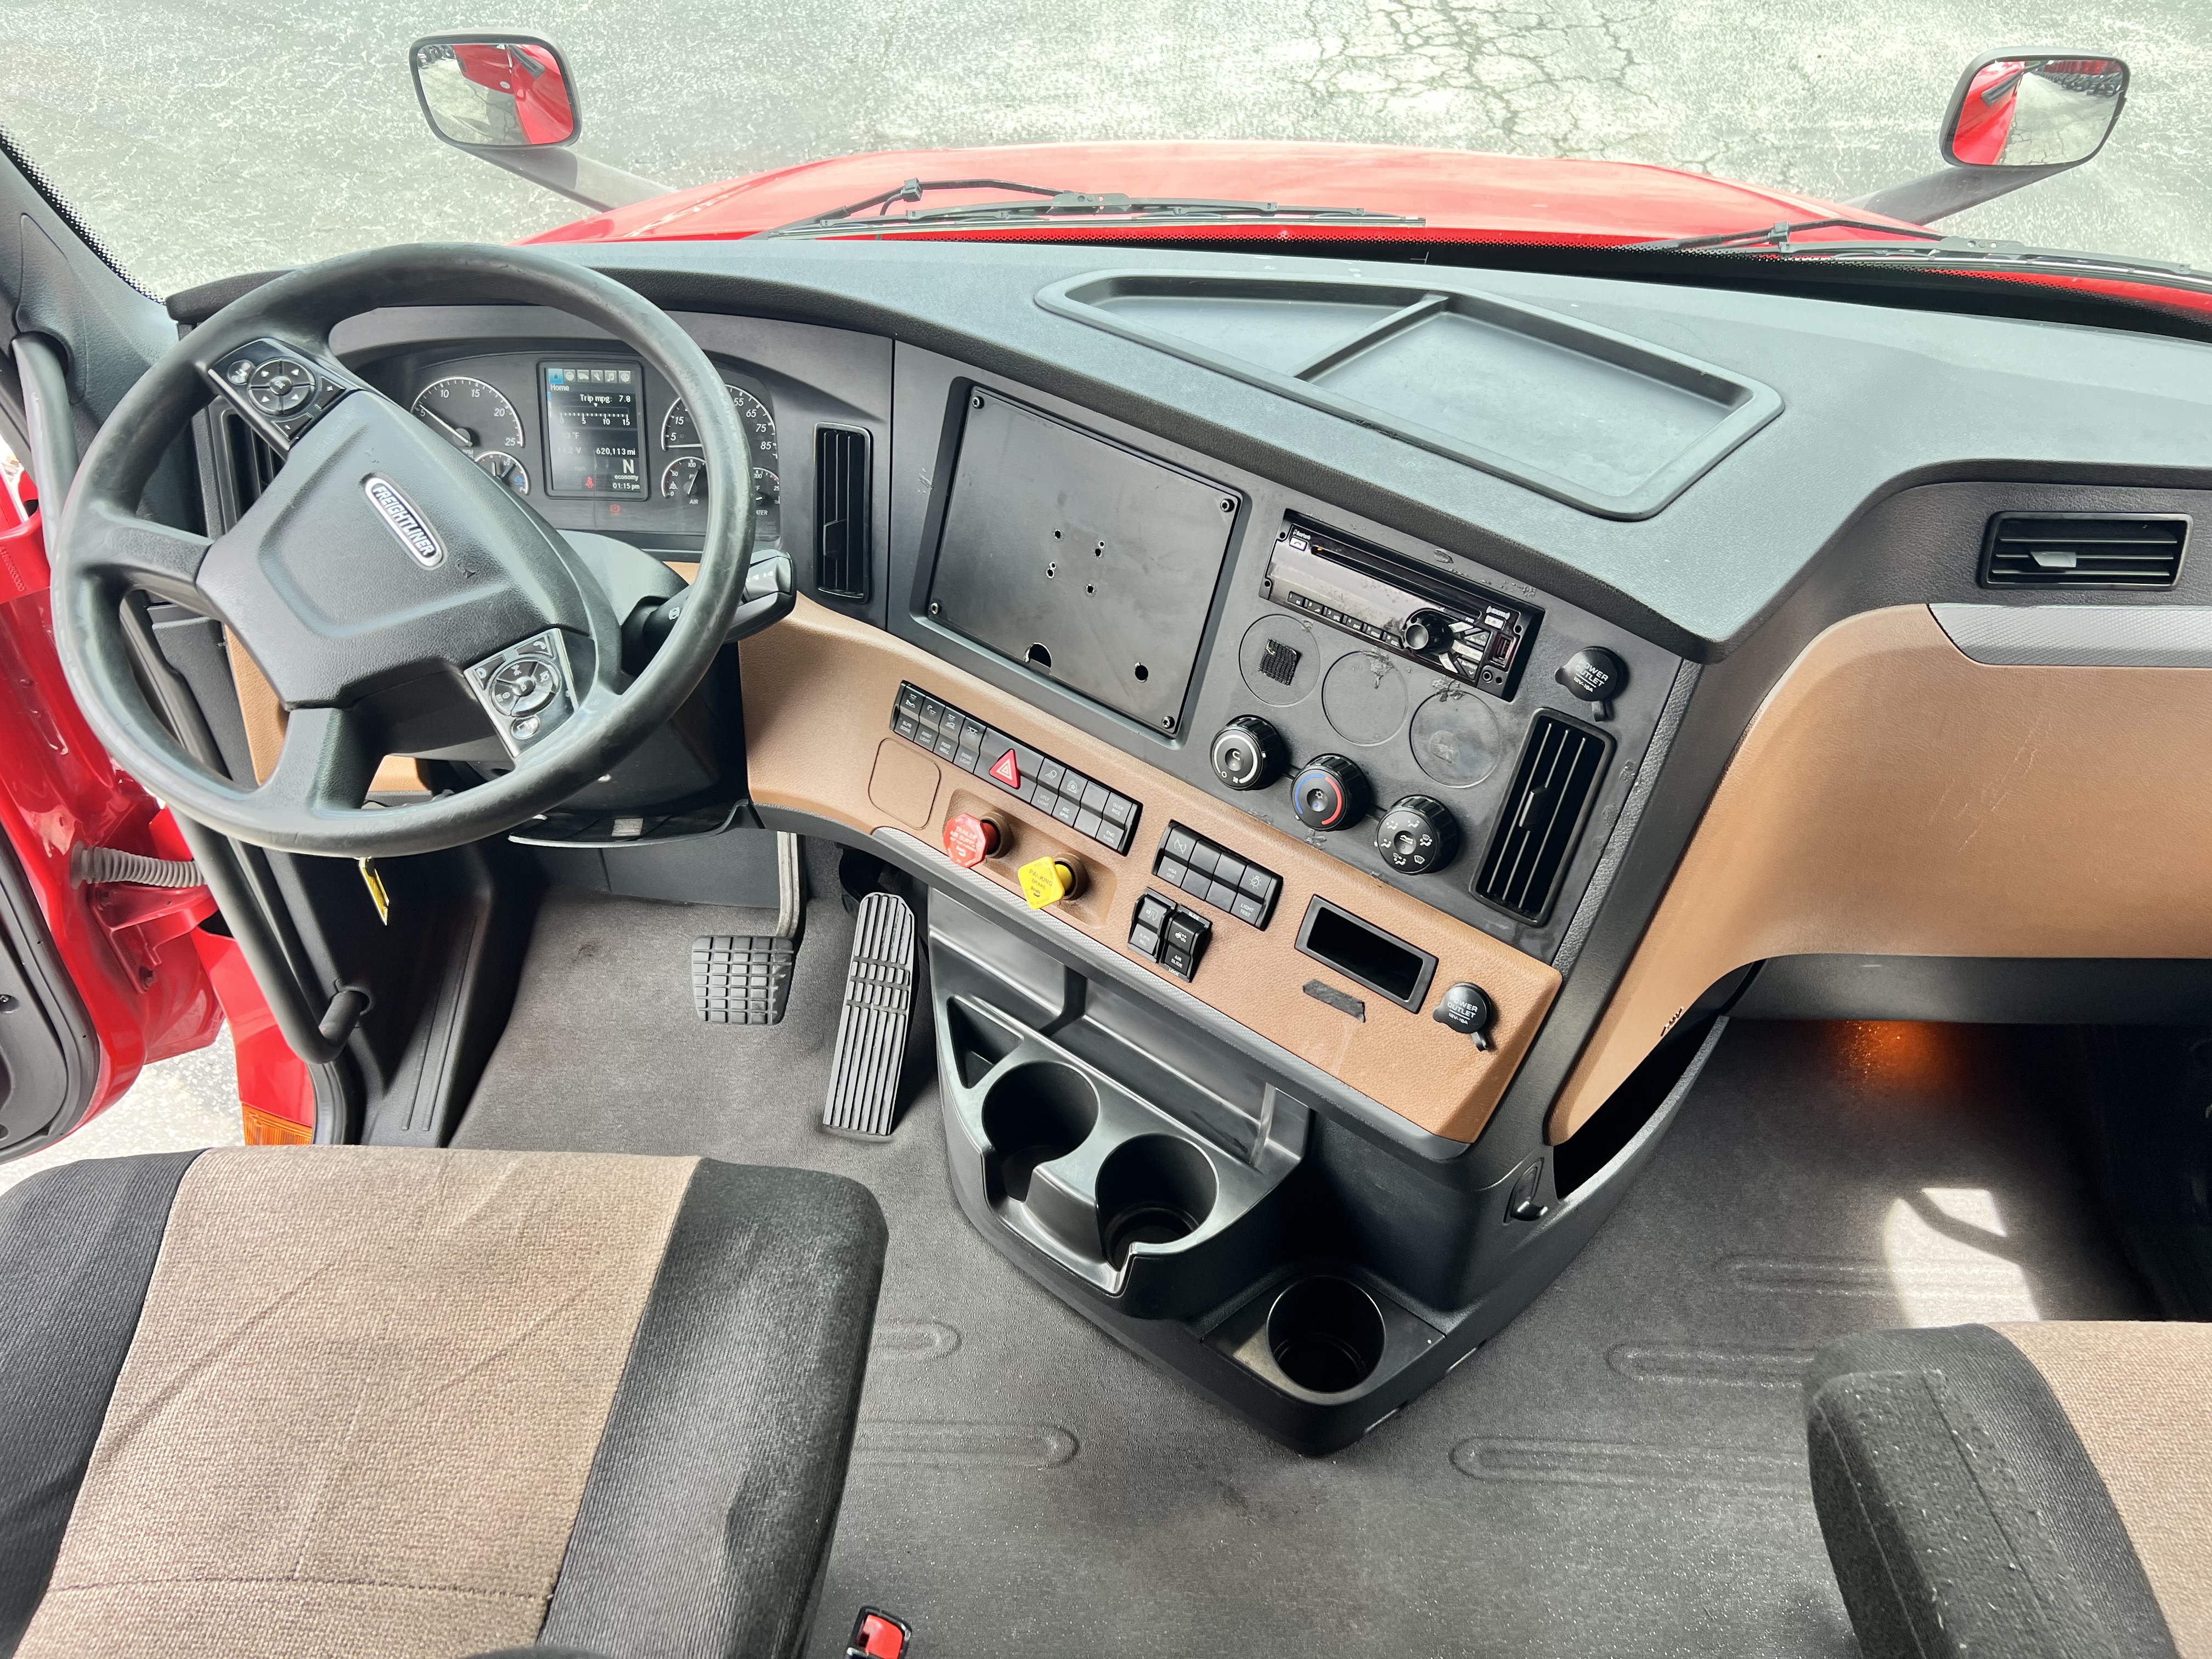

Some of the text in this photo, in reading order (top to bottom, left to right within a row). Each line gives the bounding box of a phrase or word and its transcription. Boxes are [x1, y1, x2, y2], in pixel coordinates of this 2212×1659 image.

[441, 389, 449, 398] 10
[471, 389, 480, 398] 15
[580, 394, 594, 403] Trip
[595, 396, 613, 404] mpg:
[733, 398, 743, 407] 55
[494, 408, 505, 417] 20
[746, 409, 757, 417] 65
[675, 416, 684, 425] 15
[755, 424, 766, 432] 75
[670, 432, 677, 441] 5
[505, 437, 516, 447] 25
[760, 442, 772, 450] 85
[623, 459, 635, 473] N
[373, 486, 435, 556] FREIGHTLINER
[1579, 659, 1609, 682] POWER
[1575, 664, 1605, 687] OUTLET
[939, 746, 949, 755] WELL
[960, 757, 971, 766] LIGHT
[1037, 798, 1049, 807] LIGHT
[1113, 802, 1124, 811] OVER
[1059, 811, 1069, 820] SPIN
[1111, 808, 1121, 816] RIDE
[950, 830, 958, 839] AIR
[956, 825, 977, 839] TRAILER
[1105, 830, 1115, 838] ENG
[1103, 834, 1114, 843] SHDN
[1031, 878, 1046, 890] BRAKE
[1240, 902, 1255, 912] LIGHT
[1188, 911, 1200, 921] SLIDE
[1240, 909, 1251, 917] TEST
[1171, 958, 1183, 968] SLIDE
[1168, 967, 1180, 977] LOCK
[1449, 994, 1478, 1013] POWER
[1447, 1001, 1476, 1018] OUTLET
